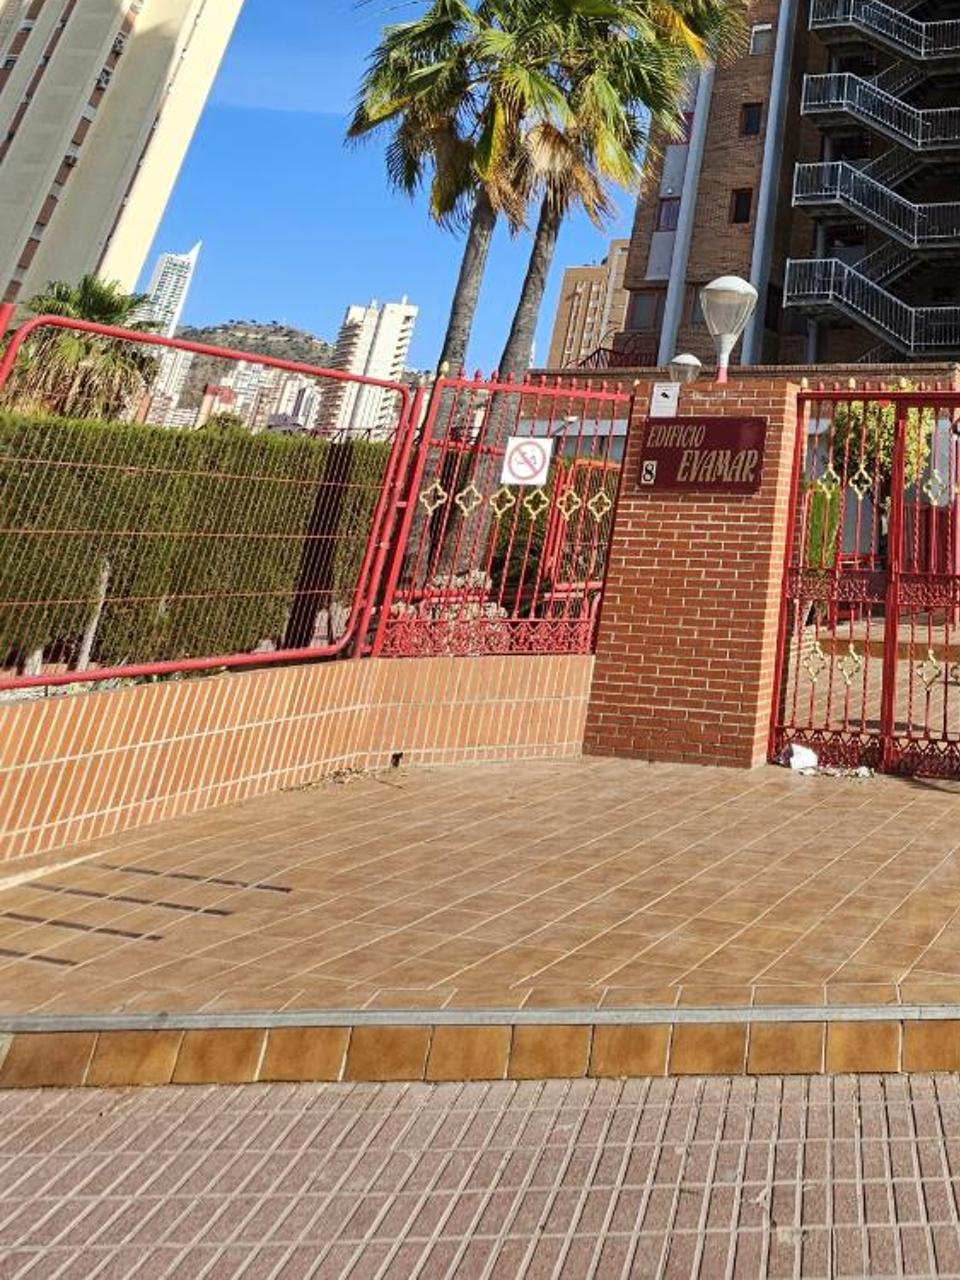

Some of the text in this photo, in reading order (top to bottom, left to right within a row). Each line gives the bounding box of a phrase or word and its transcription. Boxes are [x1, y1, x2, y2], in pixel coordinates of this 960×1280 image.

[646, 424, 706, 448] EDIFICIO
[643, 463, 655, 482] 8
[676, 450, 759, 482] EVAMAR
